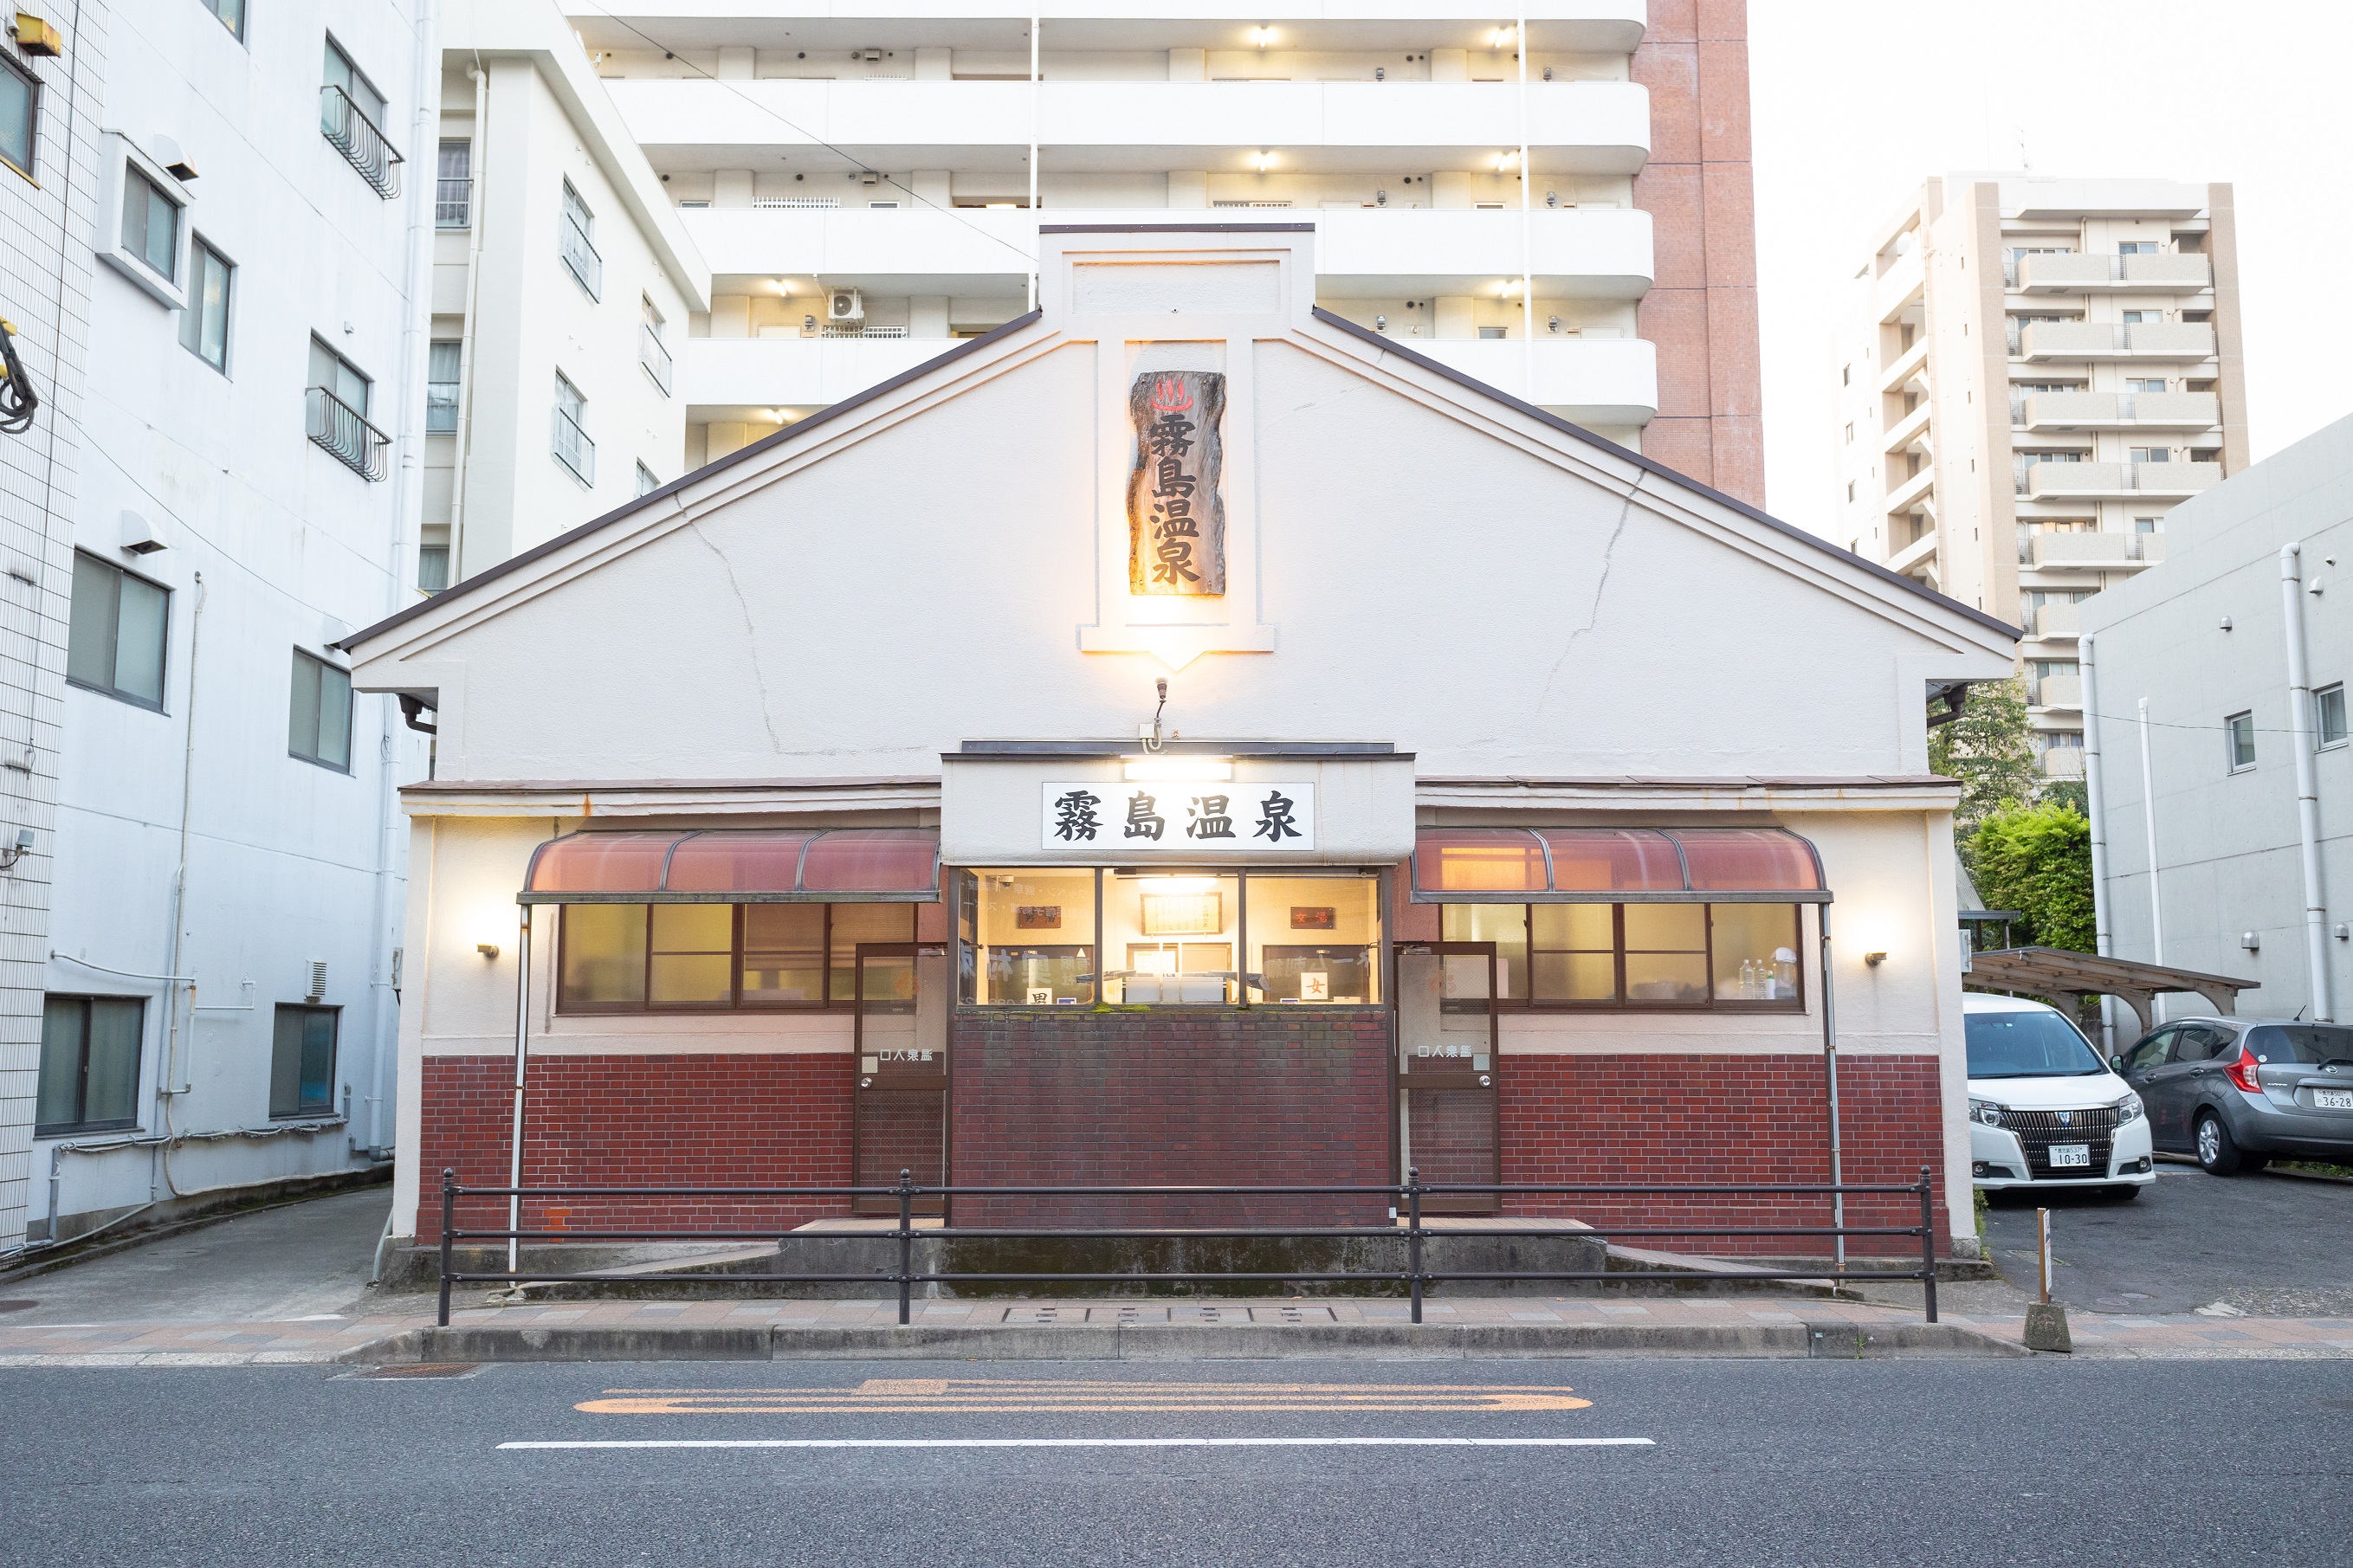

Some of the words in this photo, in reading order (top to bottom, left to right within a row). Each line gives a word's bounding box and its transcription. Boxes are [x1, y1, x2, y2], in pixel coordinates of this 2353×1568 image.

[1149, 414, 1200, 585] 霧島温泉
[1054, 790, 1303, 842] 霧島温泉
[1296, 912, 1328, 923] 女湯
[1306, 978, 1326, 994] 女
[2323, 1096, 2351, 1107] 36-28
[2059, 1153, 2087, 1165] 10-30
